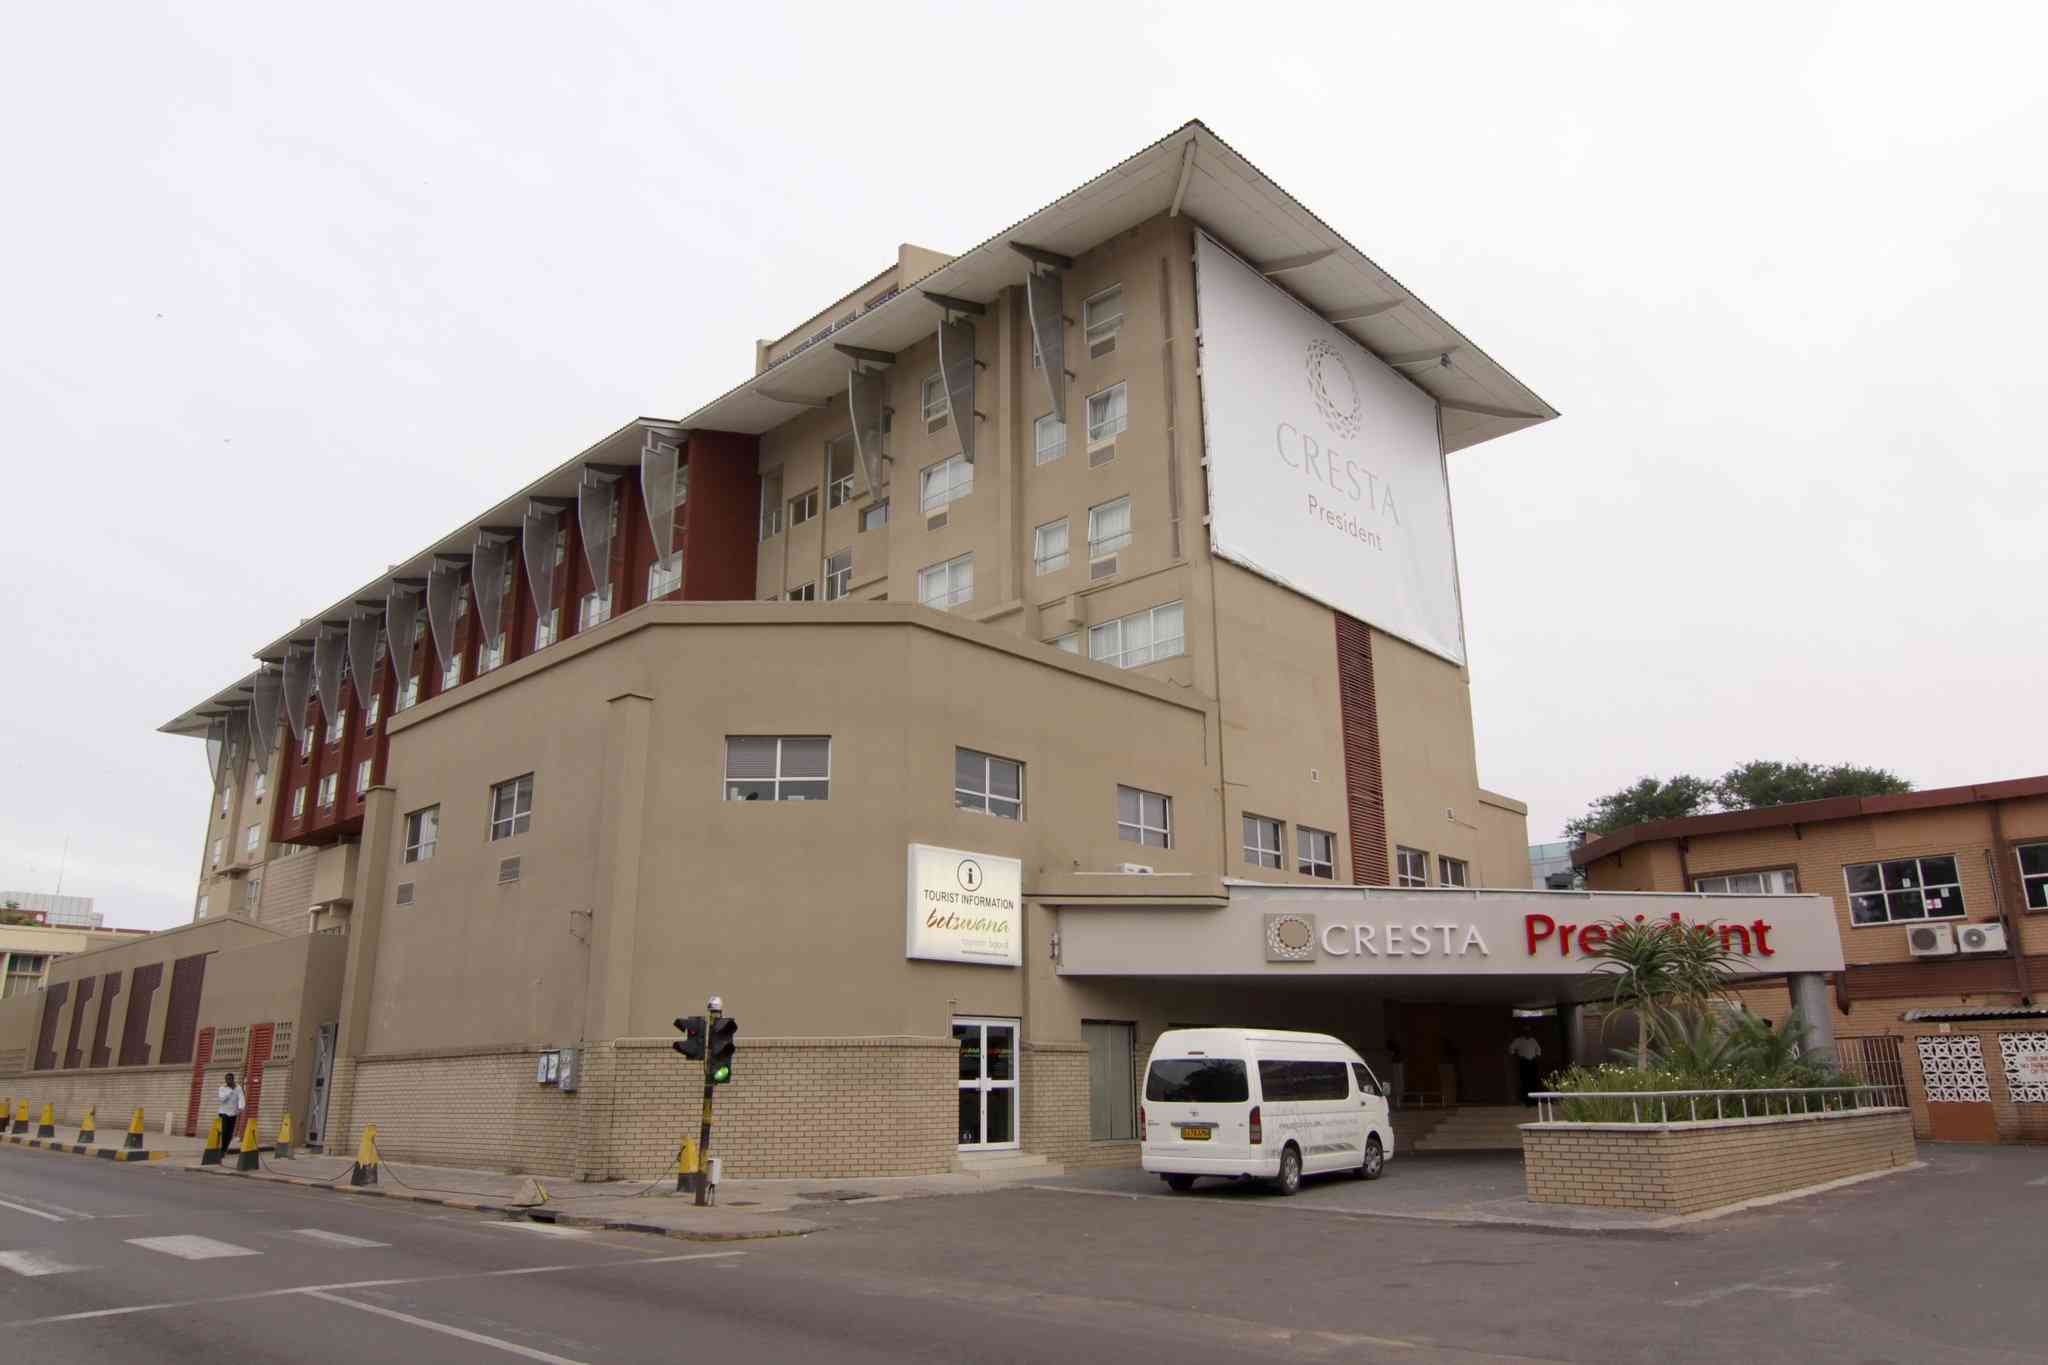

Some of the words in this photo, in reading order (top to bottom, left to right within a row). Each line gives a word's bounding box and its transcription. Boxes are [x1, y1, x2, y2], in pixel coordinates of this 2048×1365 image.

[1275, 422, 1400, 526] CRESTA
[1307, 493, 1384, 552] President
[923, 889, 959, 903] TOURIST
[961, 895, 1014, 910] INFORMATION
[926, 907, 1008, 933] botswana
[1321, 924, 1490, 957] CRESTA
[1525, 912, 1776, 957] Prent
